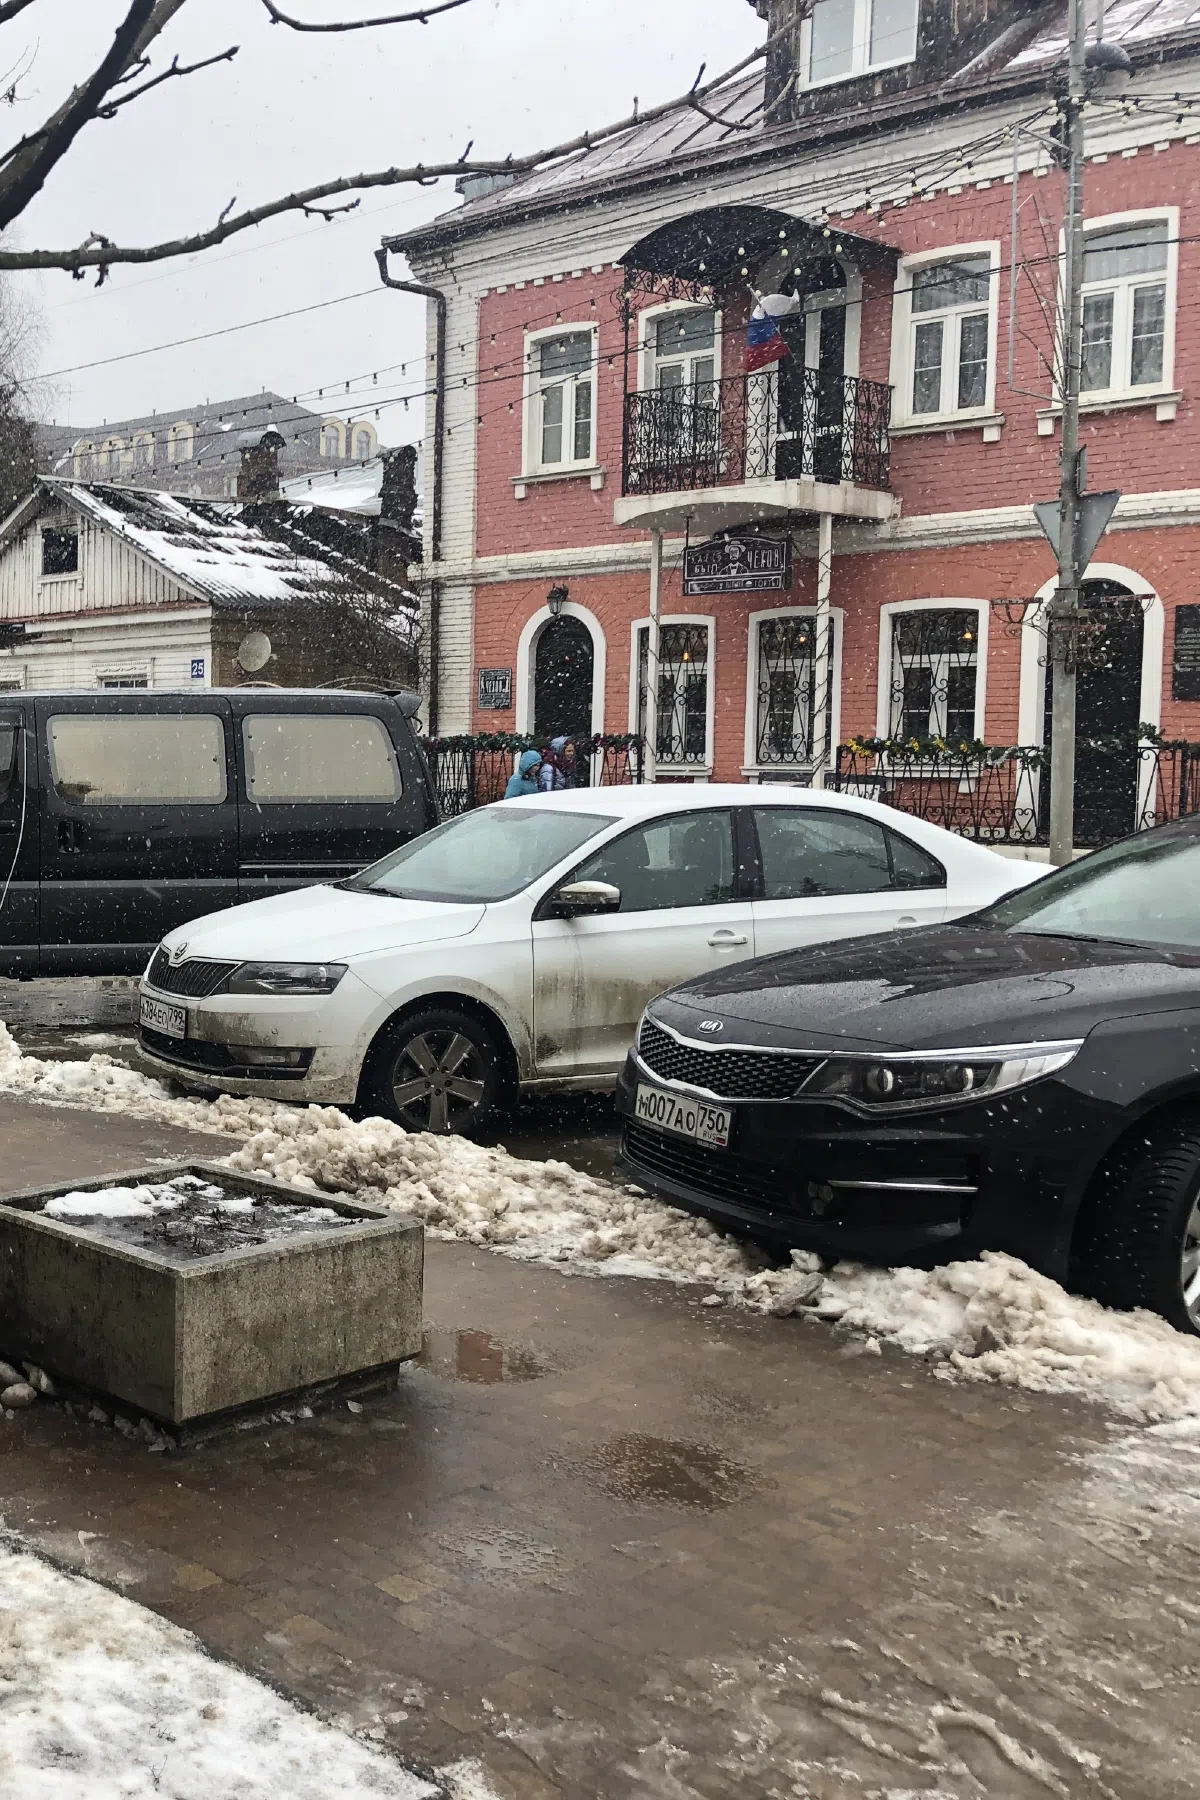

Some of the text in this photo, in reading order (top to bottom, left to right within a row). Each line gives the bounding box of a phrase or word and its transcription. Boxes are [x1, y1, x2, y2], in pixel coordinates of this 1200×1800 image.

[747, 549, 779, 569] ЧЕХОВ
[192, 662, 204, 676] 25
[169, 1007, 184, 1025] 799
[699, 1020, 719, 1031] KIA
[699, 1105, 726, 1133] 750
[702, 1130, 717, 1141] RUS
